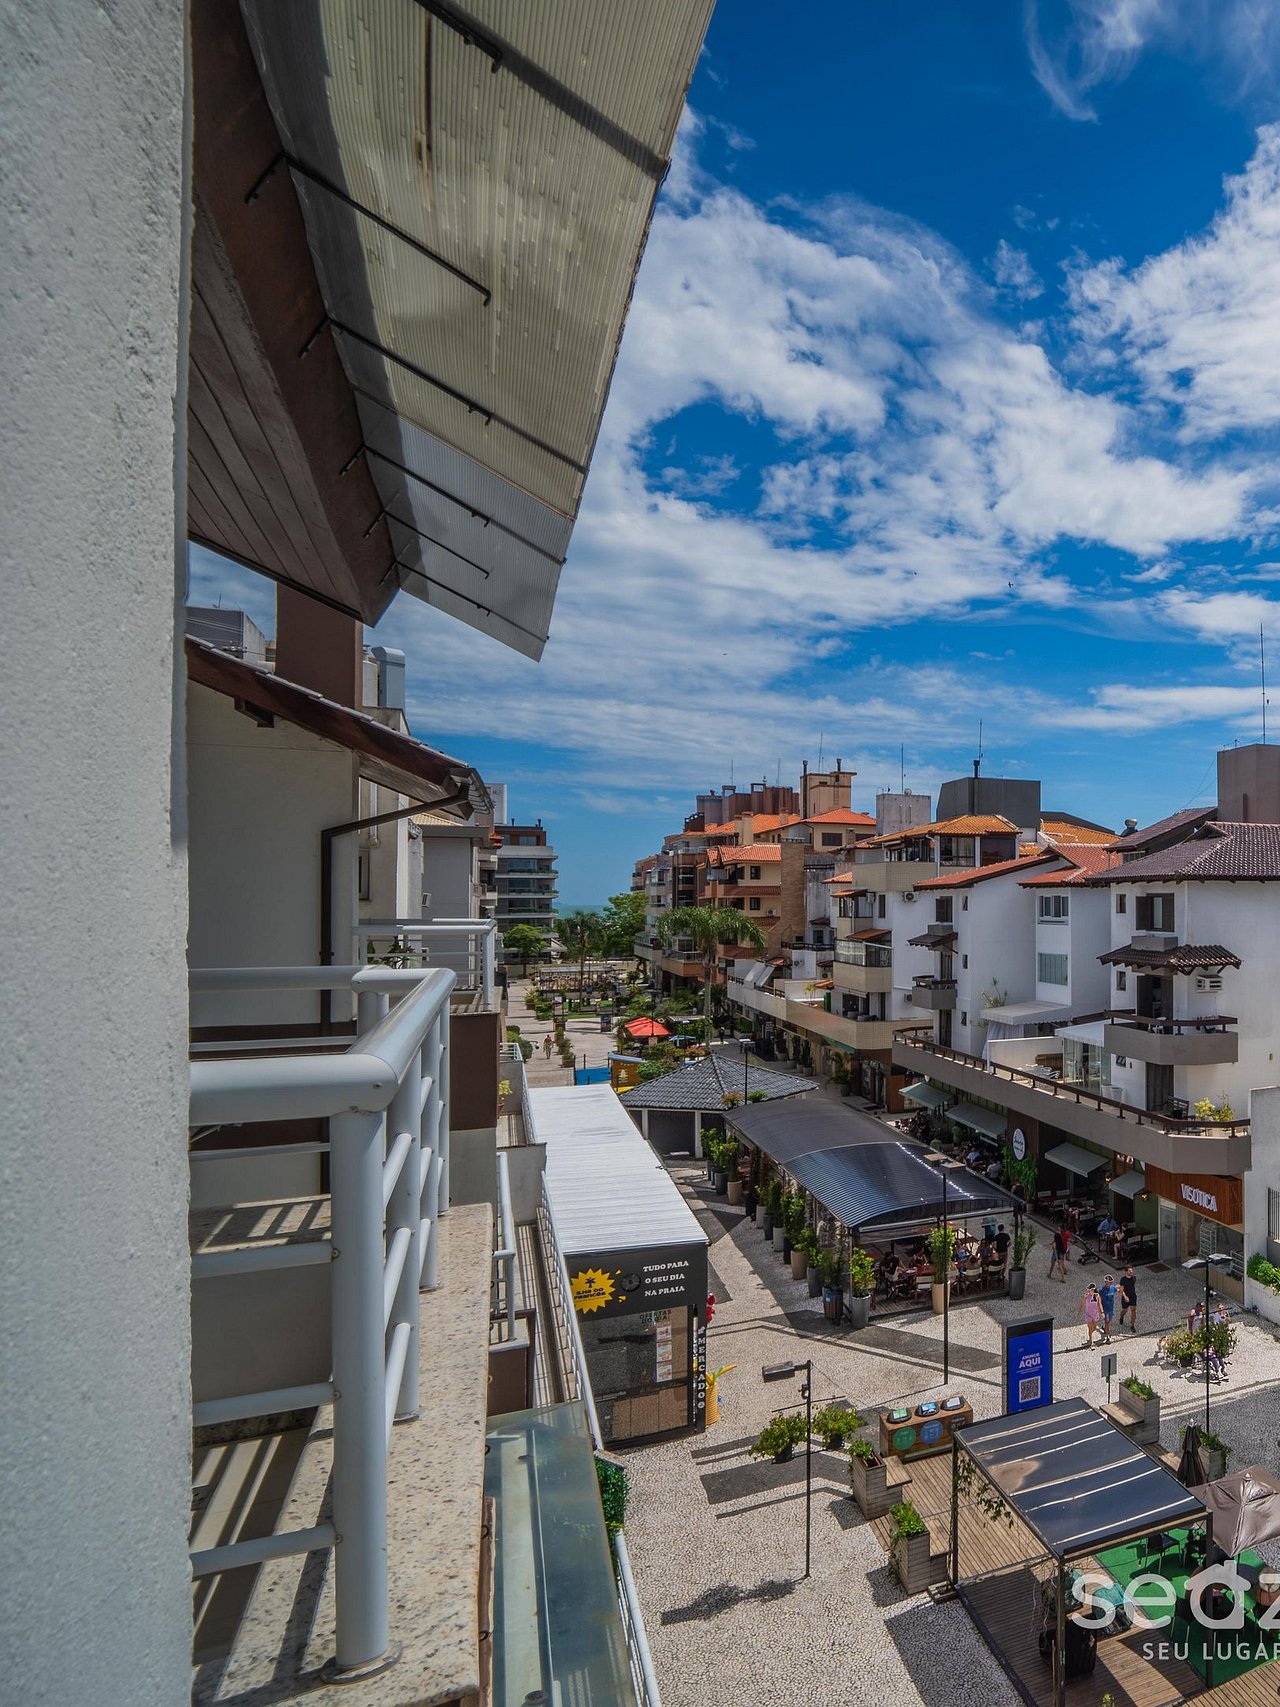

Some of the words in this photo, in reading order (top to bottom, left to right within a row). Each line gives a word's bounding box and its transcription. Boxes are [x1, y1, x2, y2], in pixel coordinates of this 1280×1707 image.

[643, 1264, 666, 1272] TUDO
[667, 1260, 689, 1269] PARA
[652, 1275, 669, 1283] SEU
[669, 1273, 685, 1281] DIA
[658, 1285, 685, 1294] PRAIA
[698, 1337, 706, 1399] MERCADO
[1018, 1356, 1041, 1369] AQUI
